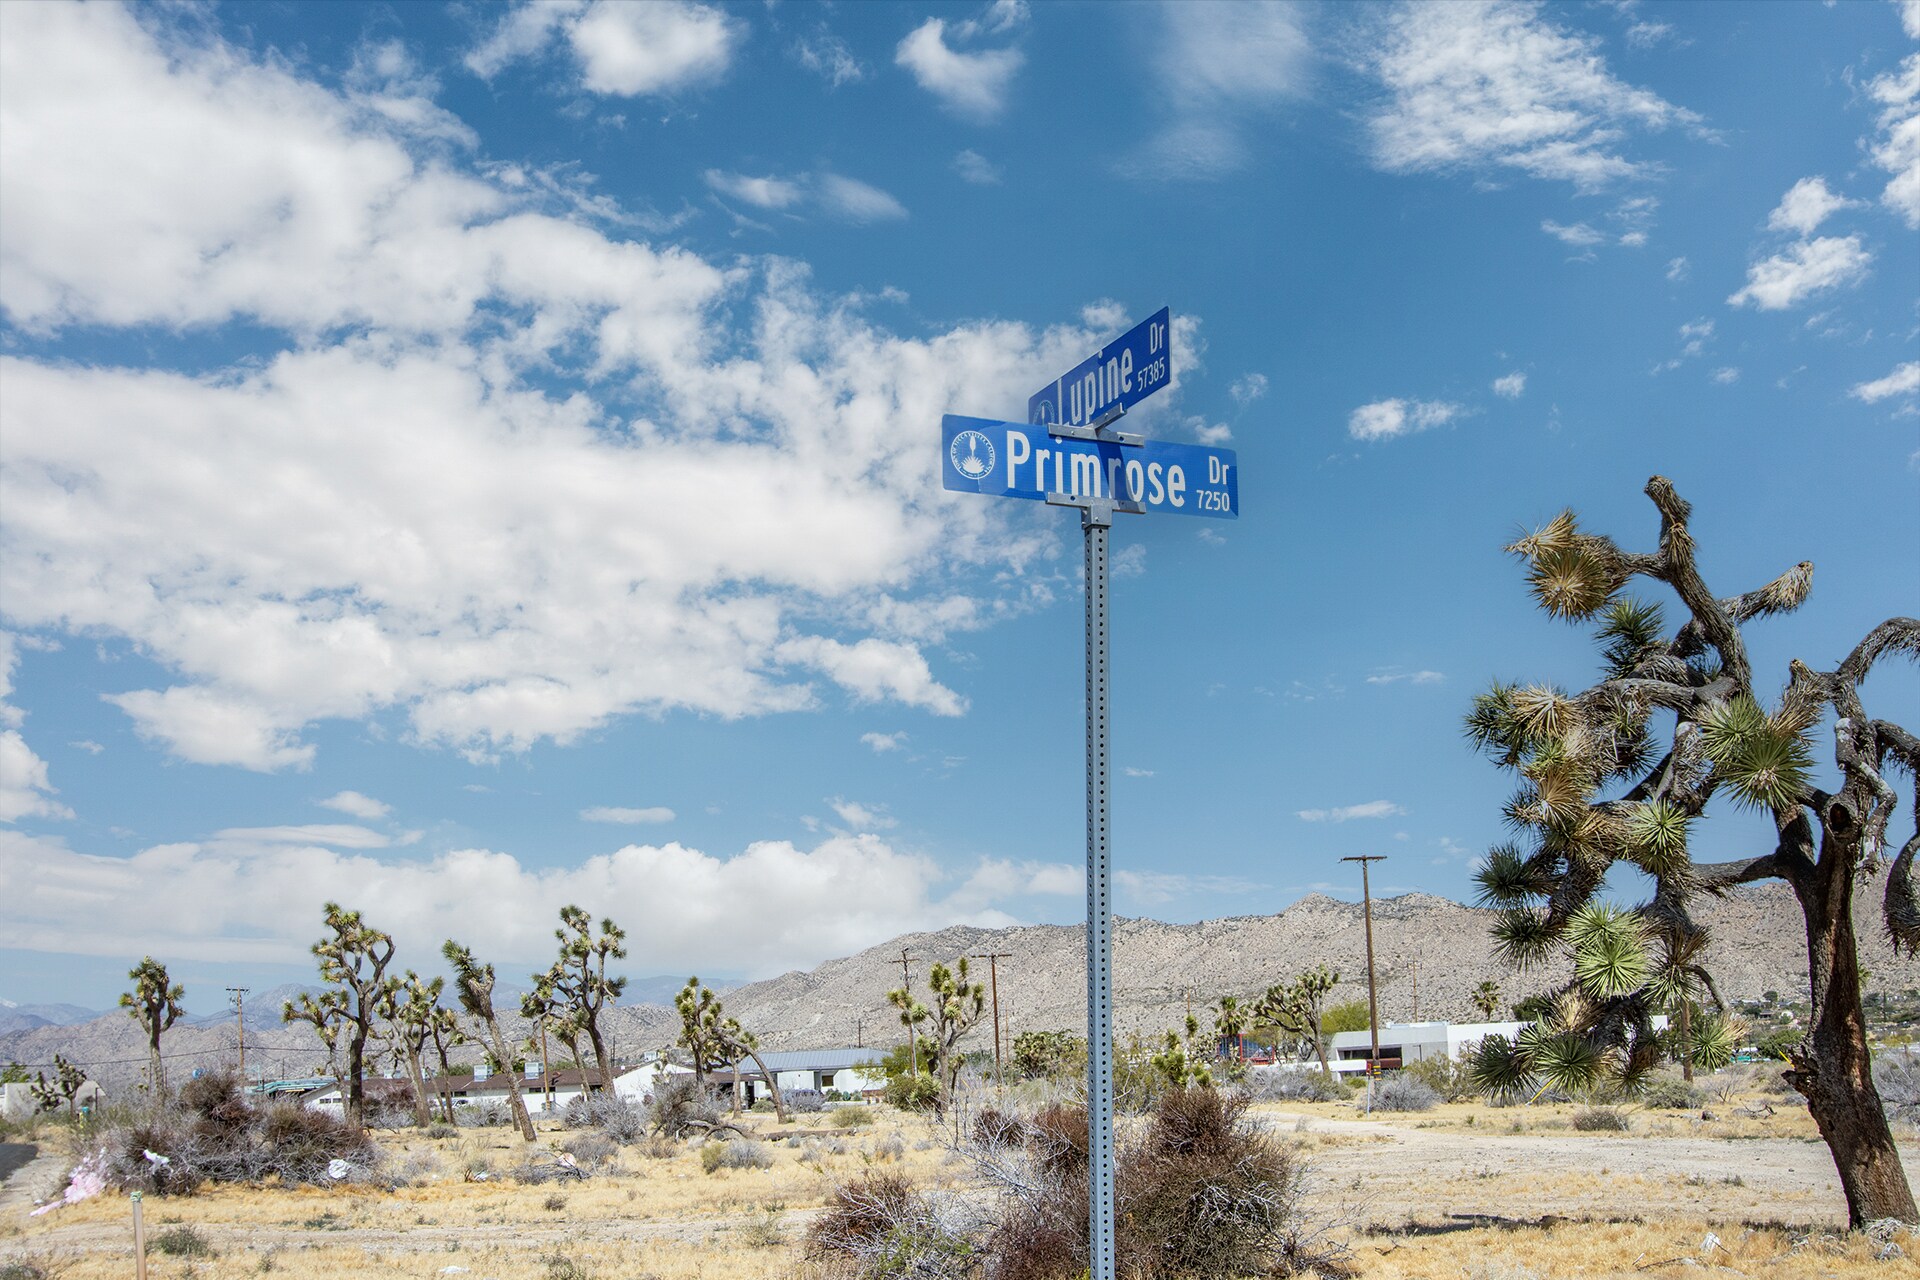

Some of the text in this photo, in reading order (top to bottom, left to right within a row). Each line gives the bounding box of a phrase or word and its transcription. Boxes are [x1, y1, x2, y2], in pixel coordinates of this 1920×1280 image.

[1057, 347, 1133, 425] Lupine
[1149, 322, 1164, 355] Dr
[1137, 356, 1165, 392] 57385
[1006, 430, 1186, 507] Primrose
[1208, 455, 1229, 485] Dr
[1196, 489, 1230, 511] 7250
